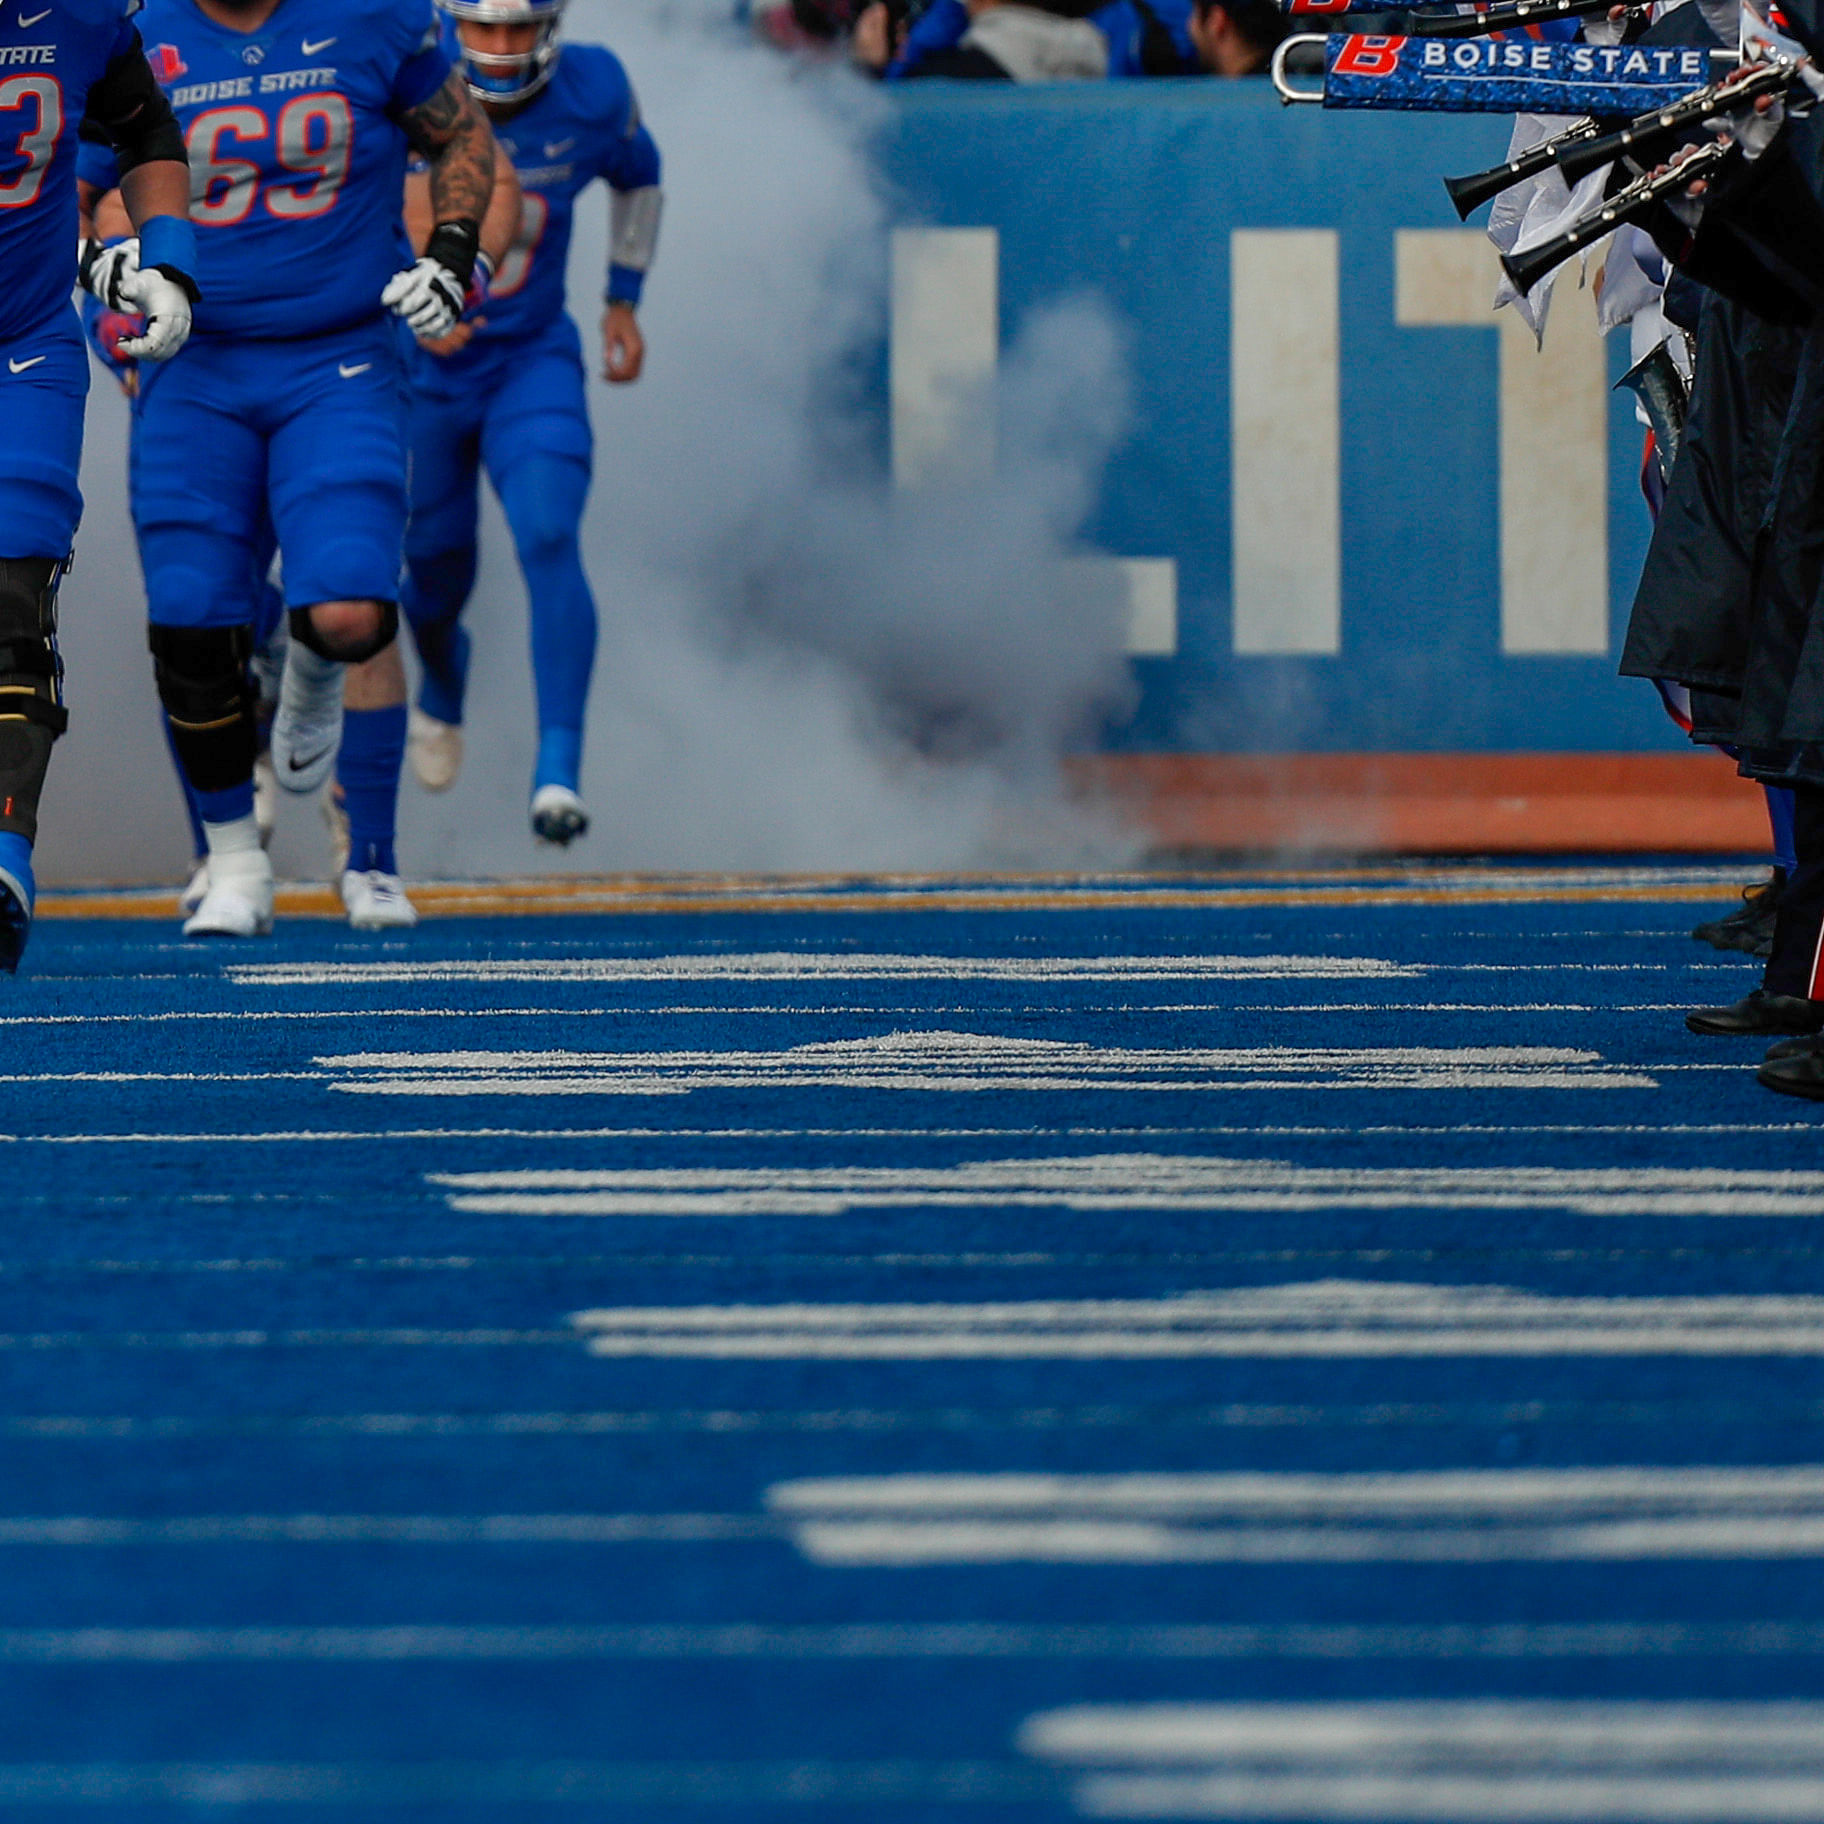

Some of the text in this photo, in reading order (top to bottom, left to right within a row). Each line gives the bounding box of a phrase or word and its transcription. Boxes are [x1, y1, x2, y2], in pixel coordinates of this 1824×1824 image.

[1424, 41, 1552, 70] BOISE
[1574, 47, 1702, 75] STATE
[172, 67, 338, 107] BOISE STATE
[185, 90, 355, 227] 69
